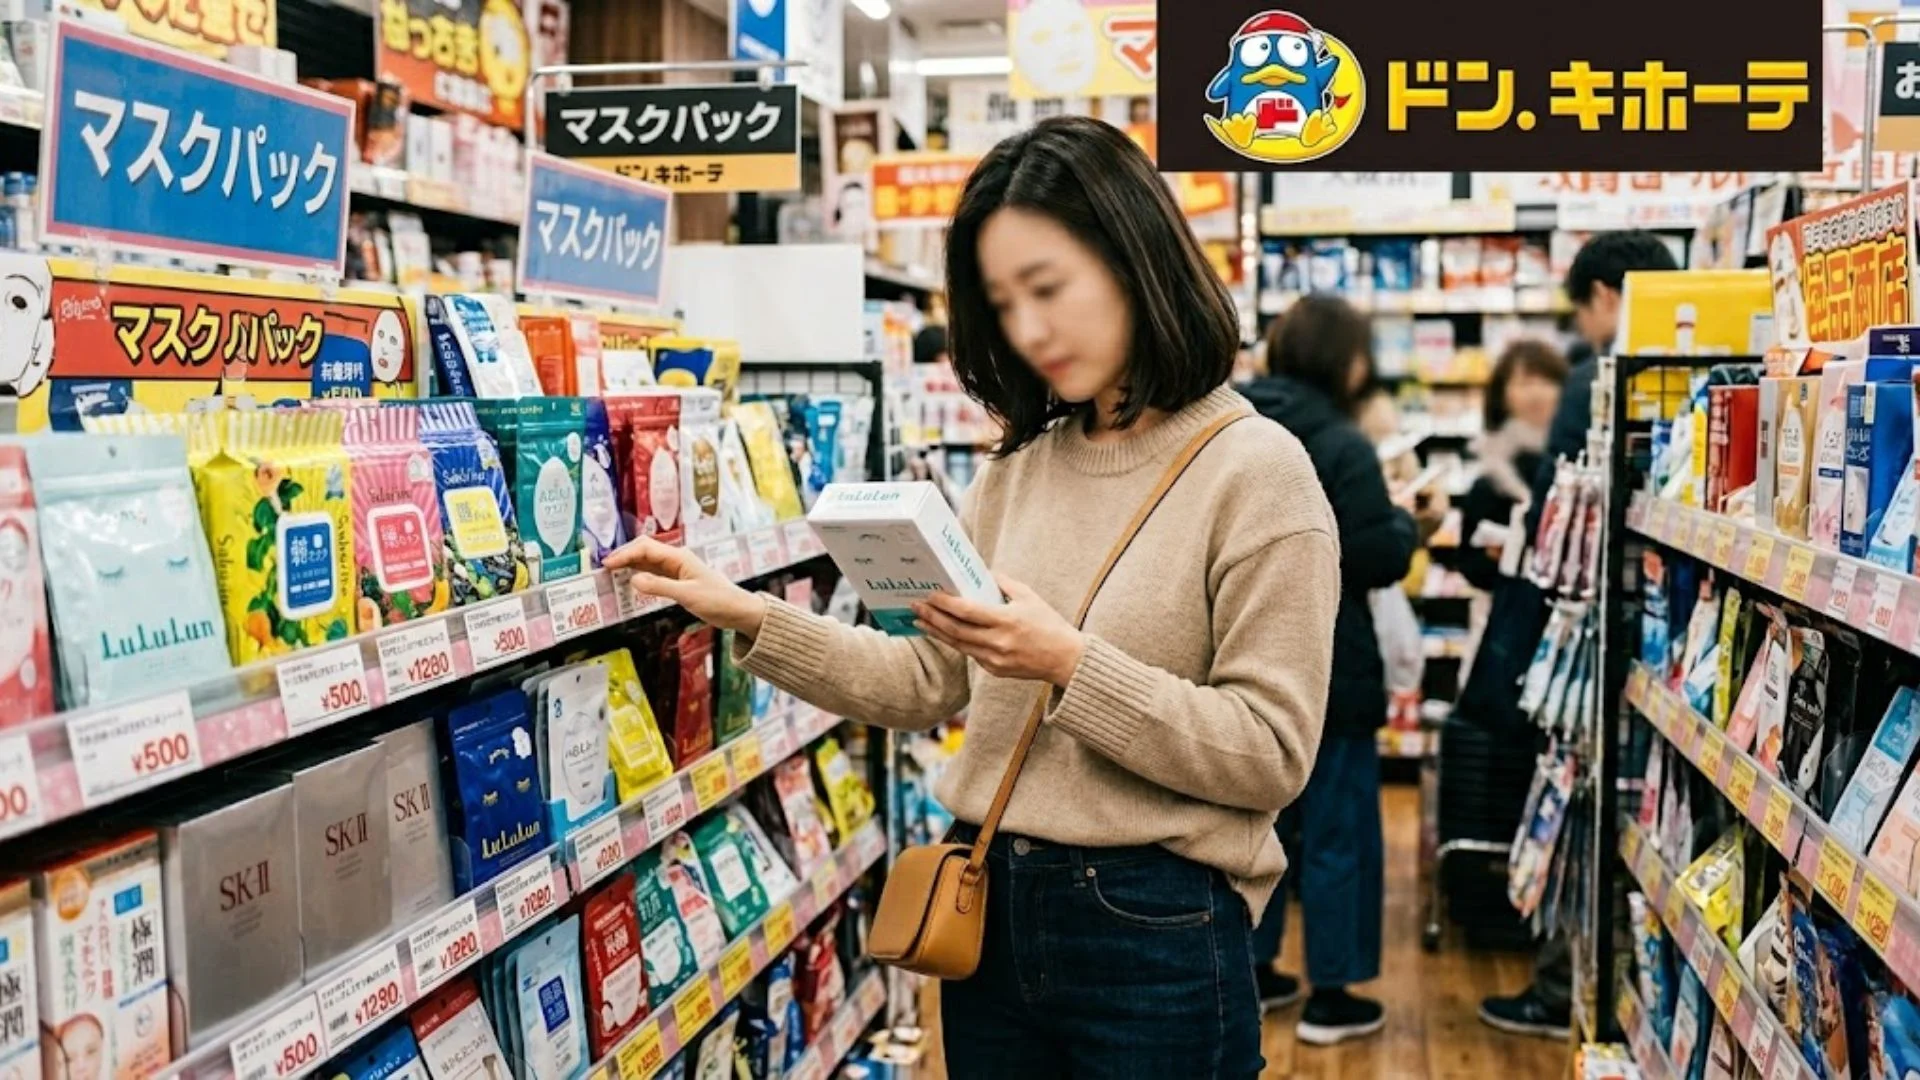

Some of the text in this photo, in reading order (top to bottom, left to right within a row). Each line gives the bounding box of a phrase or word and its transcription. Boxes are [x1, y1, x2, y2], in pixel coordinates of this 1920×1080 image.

[1256, 98, 1299, 132] ド
[1388, 61, 1808, 131] ドン.キホーテ
[560, 101, 781, 145] マスクパック
[75, 90, 337, 214] マスクパック
[536, 200, 660, 271] マスクパック
[407, 651, 449, 681] ¥1280
[320, 679, 362, 711] ¥500
[131, 733, 190, 773] ¥500
[274, 1032, 317, 1077] ¥500
